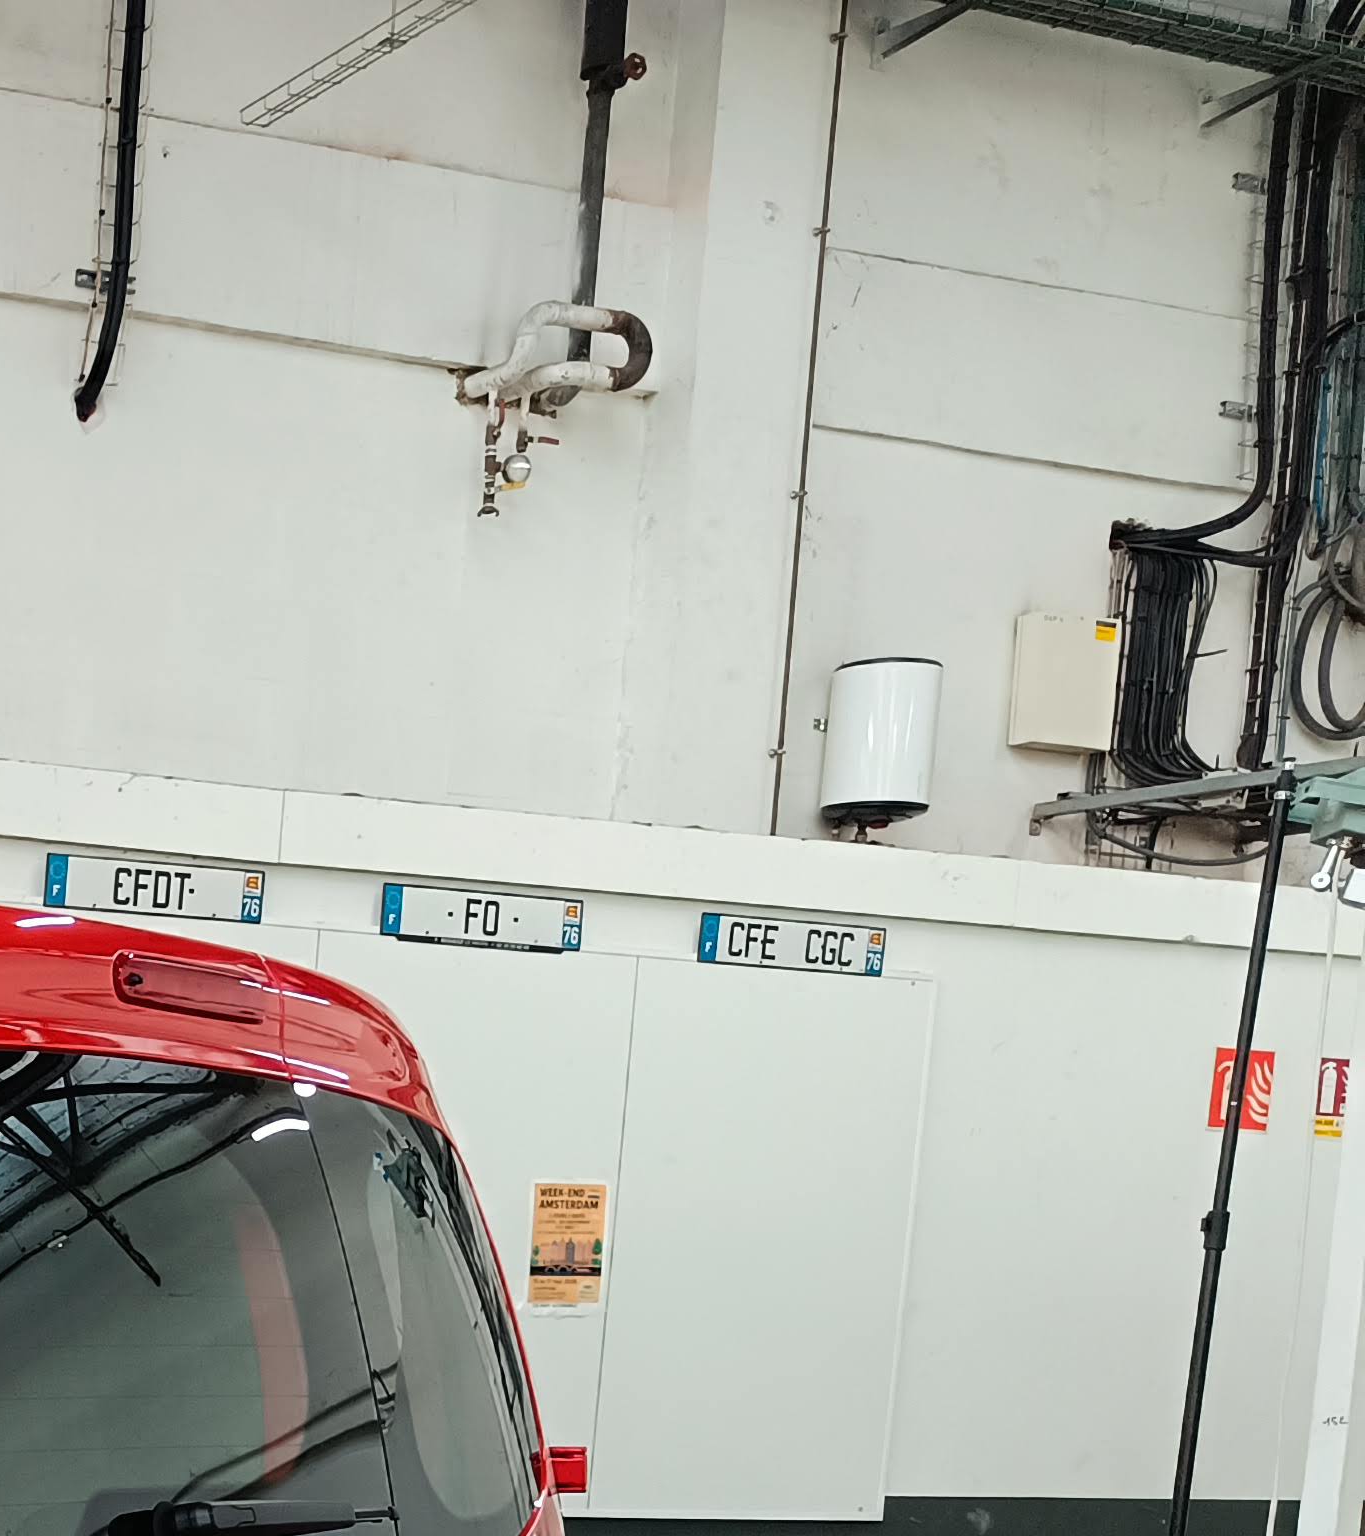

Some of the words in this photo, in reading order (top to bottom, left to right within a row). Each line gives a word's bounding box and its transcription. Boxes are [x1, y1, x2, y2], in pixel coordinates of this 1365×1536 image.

[113, 867, 192, 910] CFDT
[243, 898, 260, 917] 76
[563, 926, 579, 945] 76
[728, 921, 779, 960] CFE
[805, 929, 855, 967] CGC
[867, 953, 881, 971] 76
[540, 1187, 585, 1198] WEEK-END
[539, 1199, 599, 1209] AMSTERDAM
